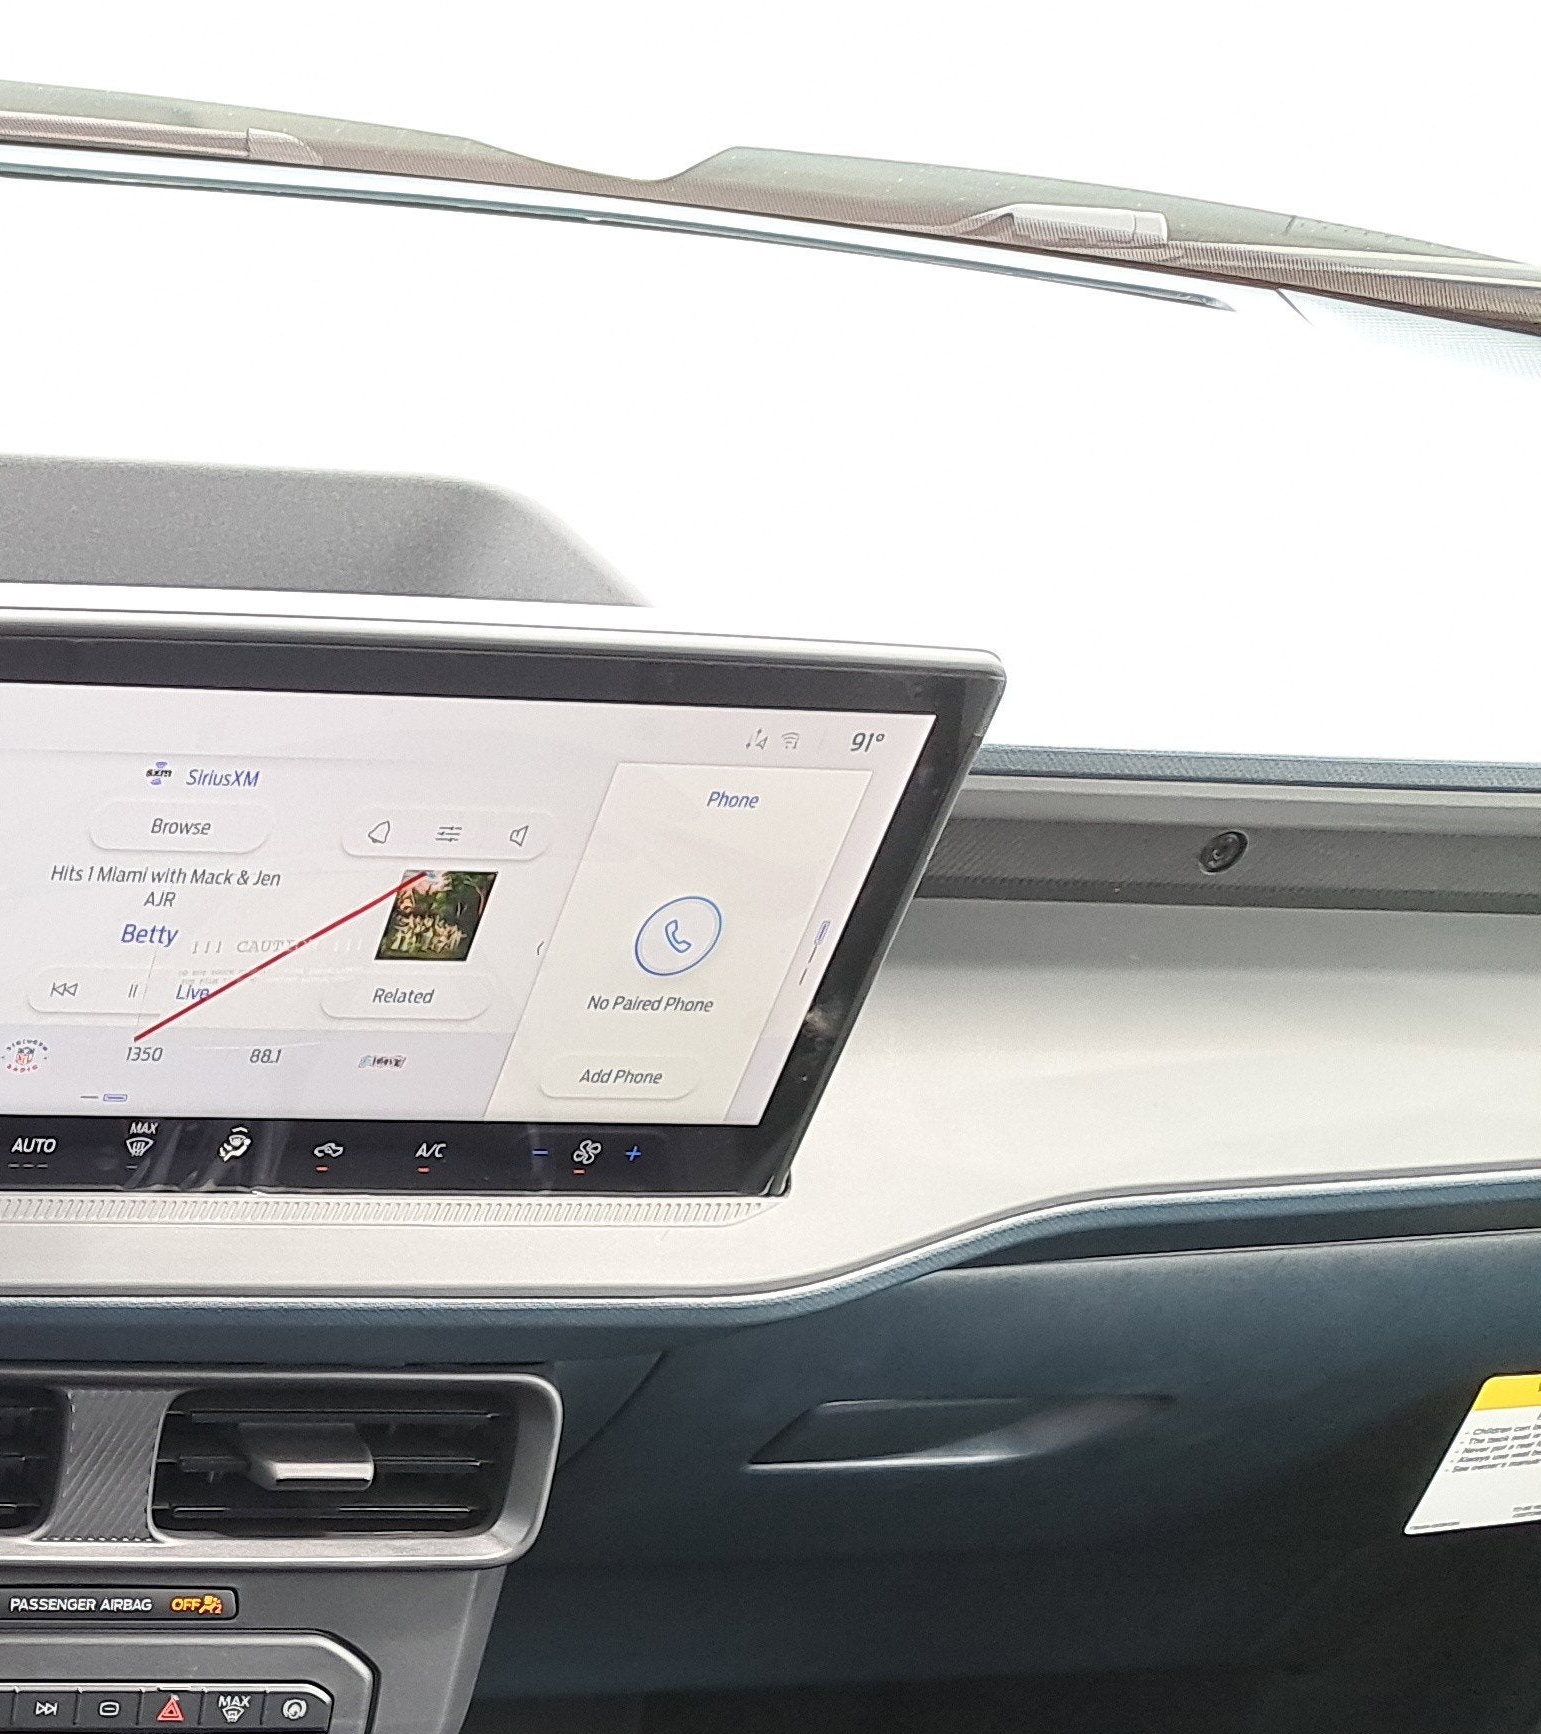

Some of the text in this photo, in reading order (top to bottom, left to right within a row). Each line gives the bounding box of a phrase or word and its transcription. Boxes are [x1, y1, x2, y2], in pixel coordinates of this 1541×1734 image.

[186, 769, 260, 787] SiriusXM
[706, 791, 760, 808] Phone
[150, 818, 212, 836] Browse
[51, 865, 83, 882] Hits
[97, 866, 148, 883] Miami
[151, 867, 187, 885] with
[190, 868, 233, 886] Mack
[237, 870, 250, 886] &
[253, 870, 282, 887] Jen
[143, 891, 177, 908] AJR
[121, 924, 179, 948] Betty
[372, 987, 435, 1005] Related
[587, 995, 714, 1012] No Paired Phone
[126, 1047, 163, 1063] 1350
[579, 1069, 663, 1084] Add Phone
[11, 1138, 57, 1153] AUTO
[416, 1143, 447, 1158] A/C
[10, 1598, 97, 1611] PASSENGER
[100, 1598, 152, 1611] AIRBAG
[171, 1599, 200, 1611] OFF
[219, 1695, 251, 1708] MAX
